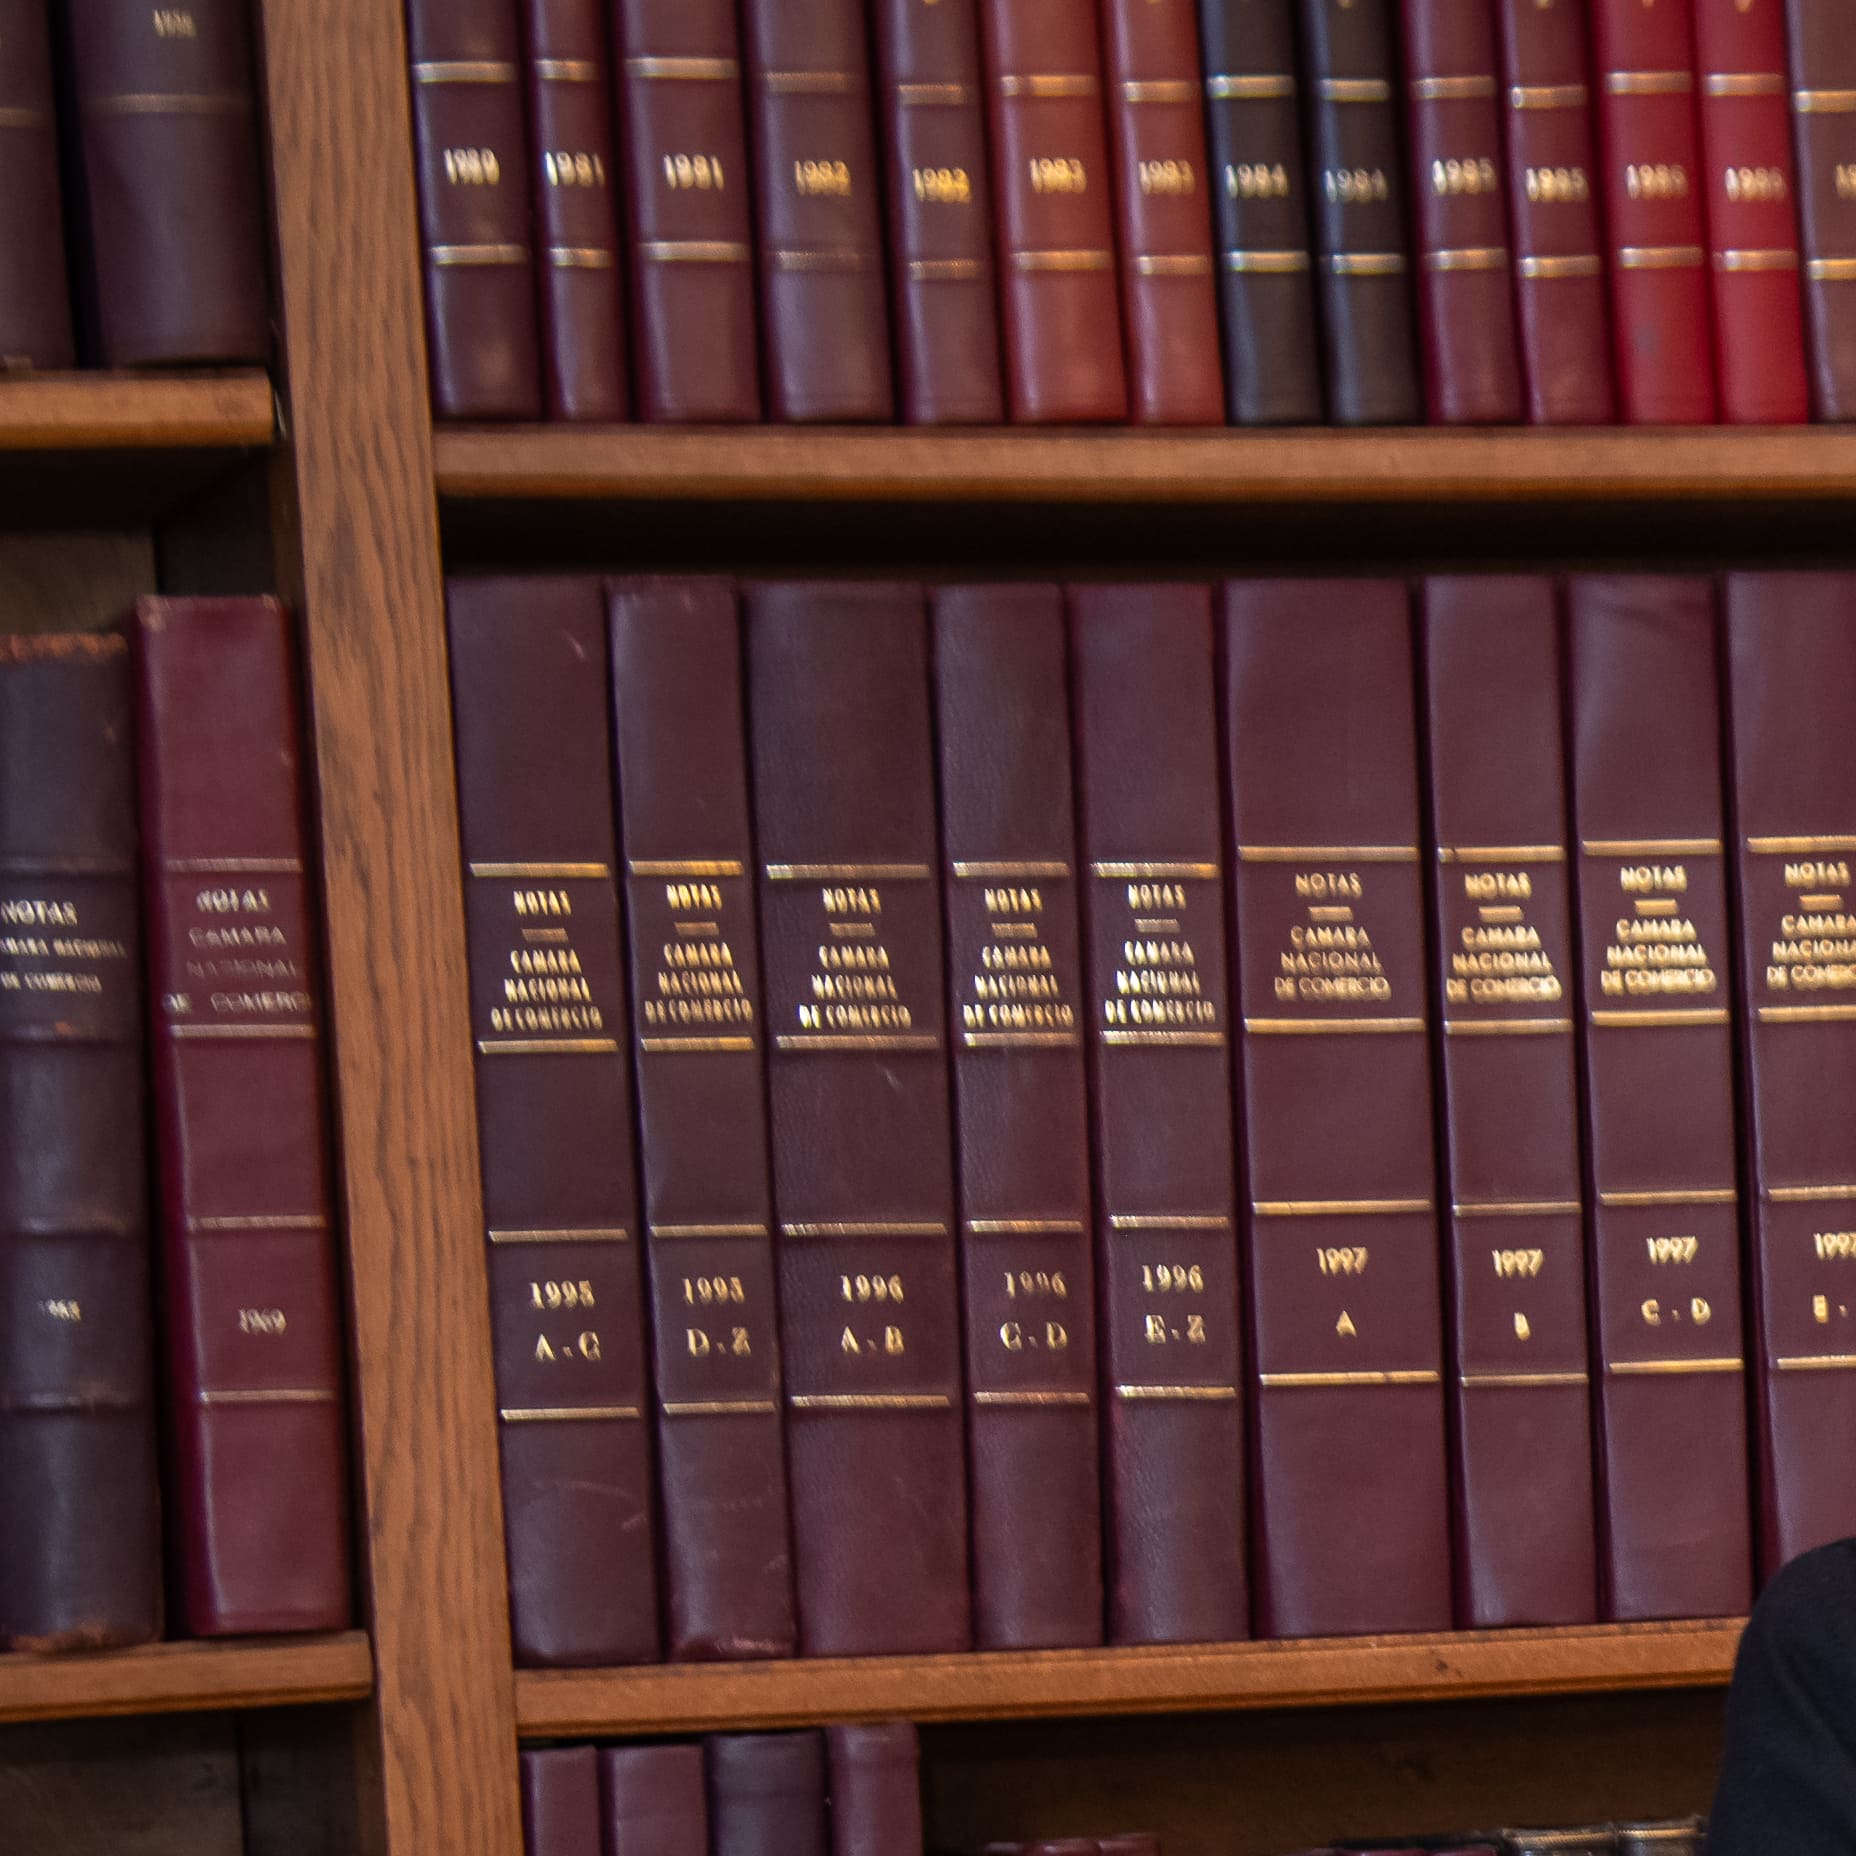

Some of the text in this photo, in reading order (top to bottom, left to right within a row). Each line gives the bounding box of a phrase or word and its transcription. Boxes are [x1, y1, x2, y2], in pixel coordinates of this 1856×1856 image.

[1295, 874, 1362, 898] NOTAS
[1465, 874, 1531, 898] NOTAS
[1620, 867, 1687, 892] NOTAS
[1785, 863, 1850, 888] NOTAS
[514, 891, 571, 916] NOTAS
[666, 885, 722, 909] NOTAS
[823, 888, 881, 913] NOTAS
[984, 888, 1041, 913] NOTAS
[1128, 885, 1186, 909] NOTAS
[1290, 926, 1369, 949] CAMARA
[1461, 926, 1541, 949] CAMARA
[1616, 919, 1695, 941] CAMARA
[510, 950, 580, 974] CAMARA
[664, 943, 732, 967] CAMARA
[1281, 951, 1382, 974] NACIONAL
[1452, 952, 1552, 974] NACIONAL
[1607, 945, 1707, 968] NACIONAL
[504, 978, 591, 1001] NACIONAL
[658, 972, 742, 995] NACIONAL
[811, 975, 897, 998] NACIONAL
[974, 974, 1058, 998] NACIONAL
[1116, 971, 1200, 995] NACIONAL
[1274, 976, 1391, 1001] DE COMERCIO
[1447, 977, 1562, 1002] DE COMERCIO
[1601, 969, 1716, 995] DE COMERCIO
[1767, 966, 1788, 990] DE
[826, 1004, 911, 1029] COMERCIO
[989, 1004, 1072, 1027] COMERCIO
[1317, 1247, 1367, 1274] 1997
[1647, 1236, 1697, 1265] 1997
[1491, 1249, 1542, 1277] 1997
[840, 1275, 904, 1303] 1996
[1142, 1265, 1204, 1292] 1996
[1336, 1311, 1356, 1336] A
